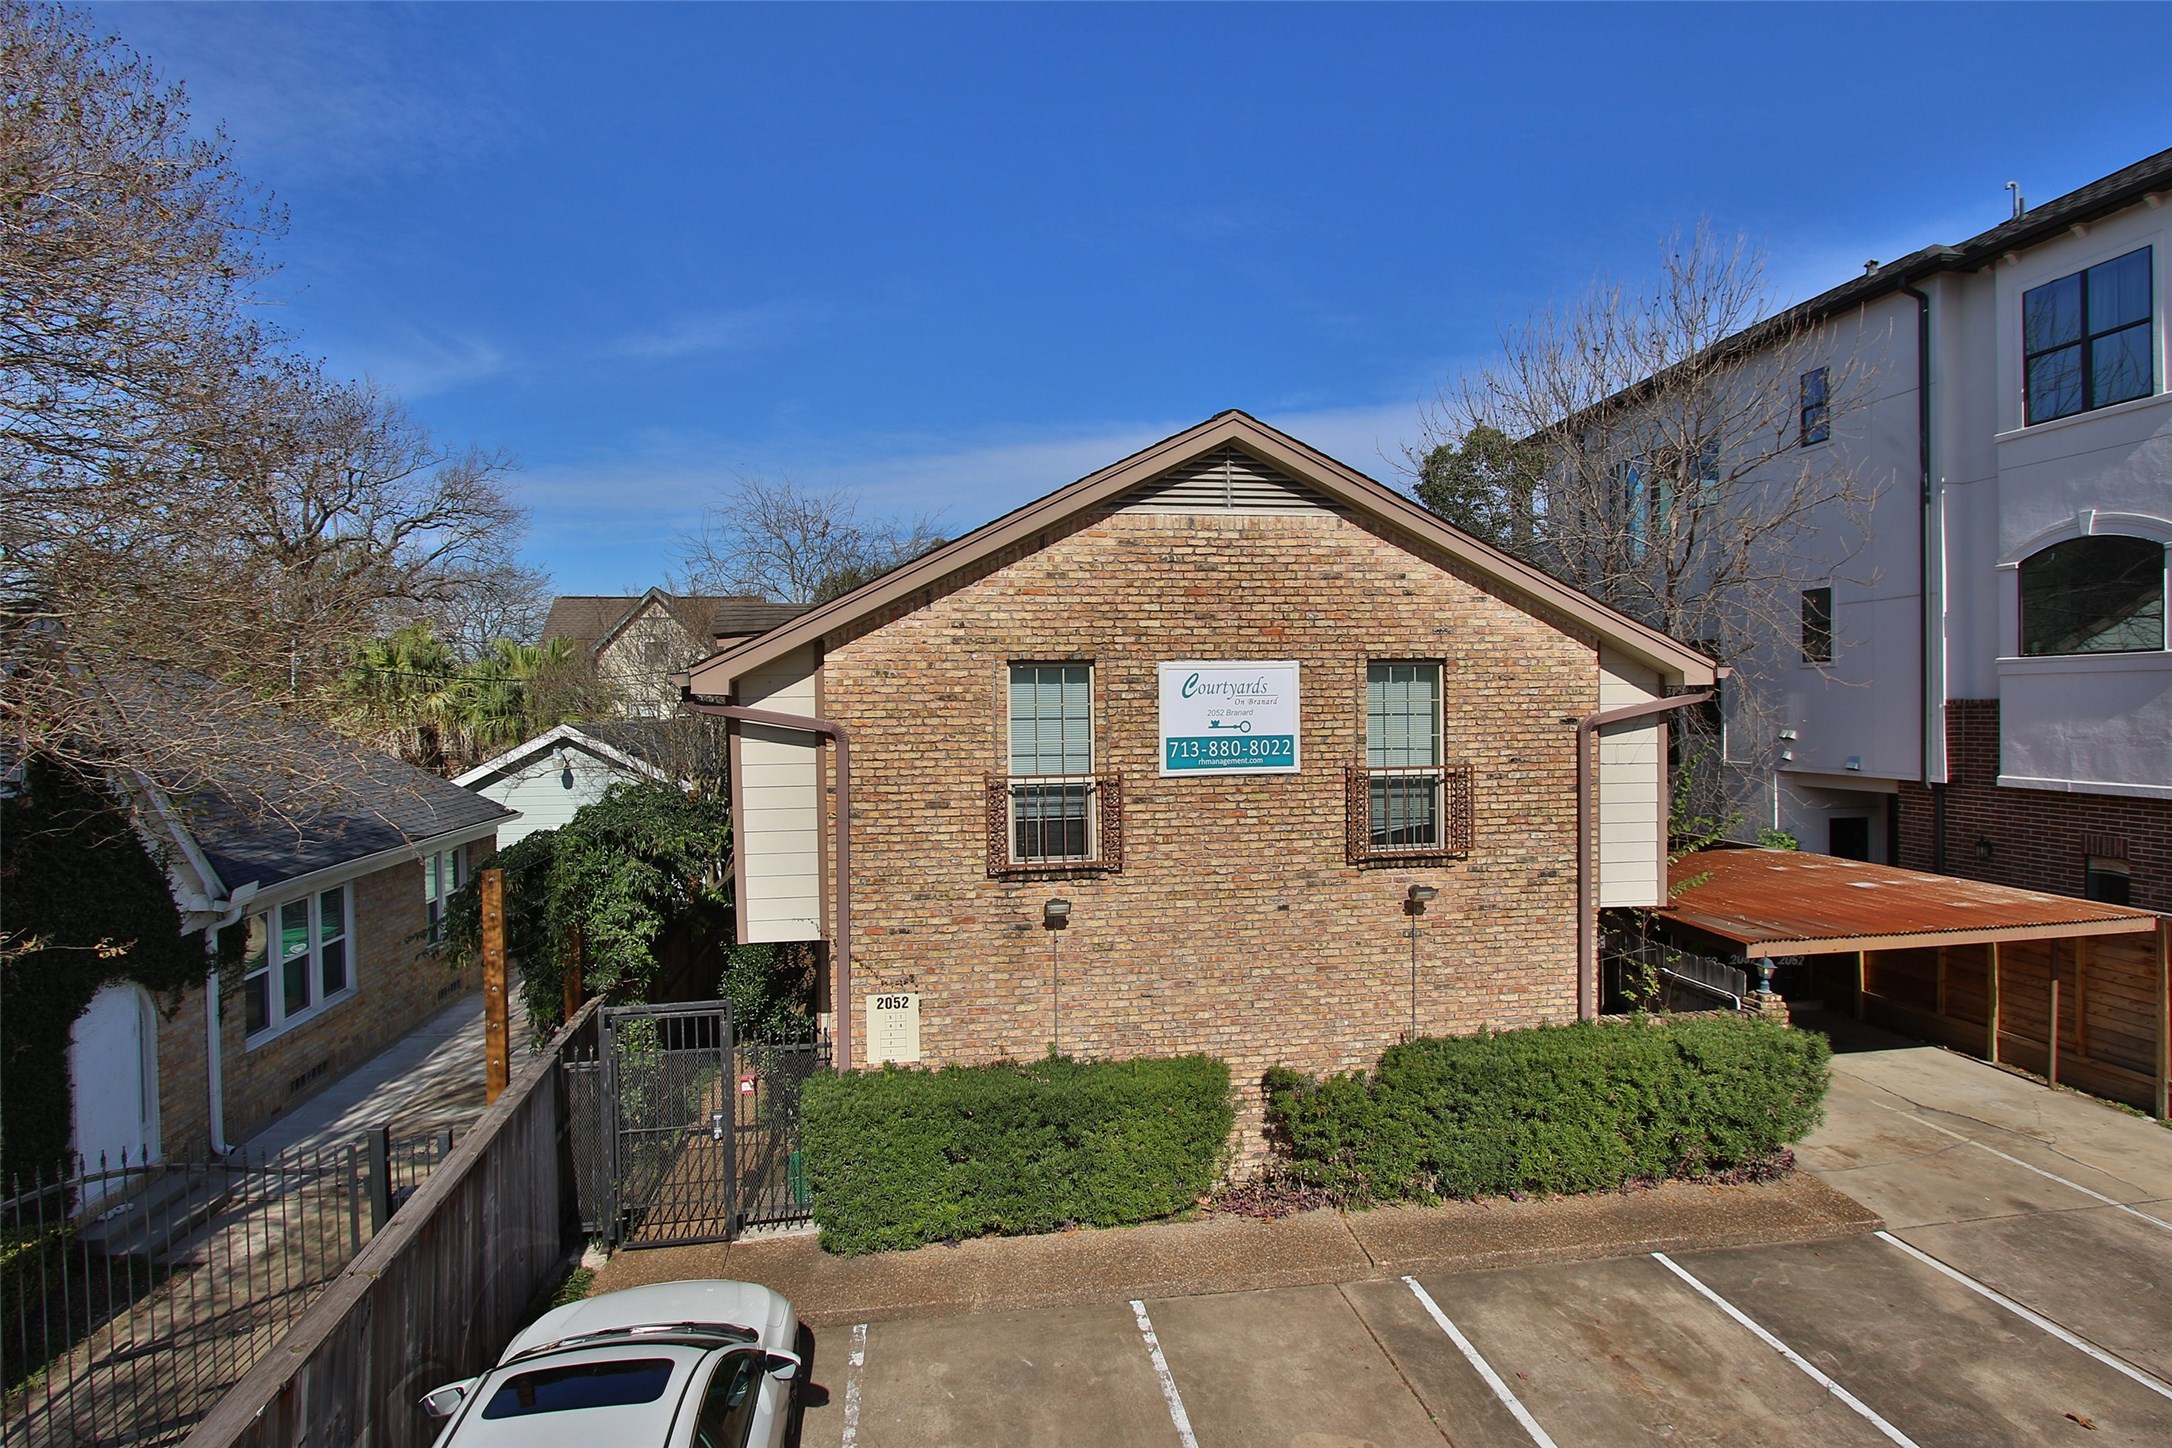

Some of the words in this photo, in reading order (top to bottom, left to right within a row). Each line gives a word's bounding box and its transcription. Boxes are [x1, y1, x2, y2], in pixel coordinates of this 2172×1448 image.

[1181, 672, 1268, 700] Courtyards
[1248, 697, 1278, 705] Branard
[1207, 709, 1225, 717] 2052
[1226, 708, 1254, 717] Branard
[1169, 739, 1291, 758] 713-880-8022
[1198, 757, 1264, 766] rhmanagement.com
[876, 996, 909, 1010] 2052
